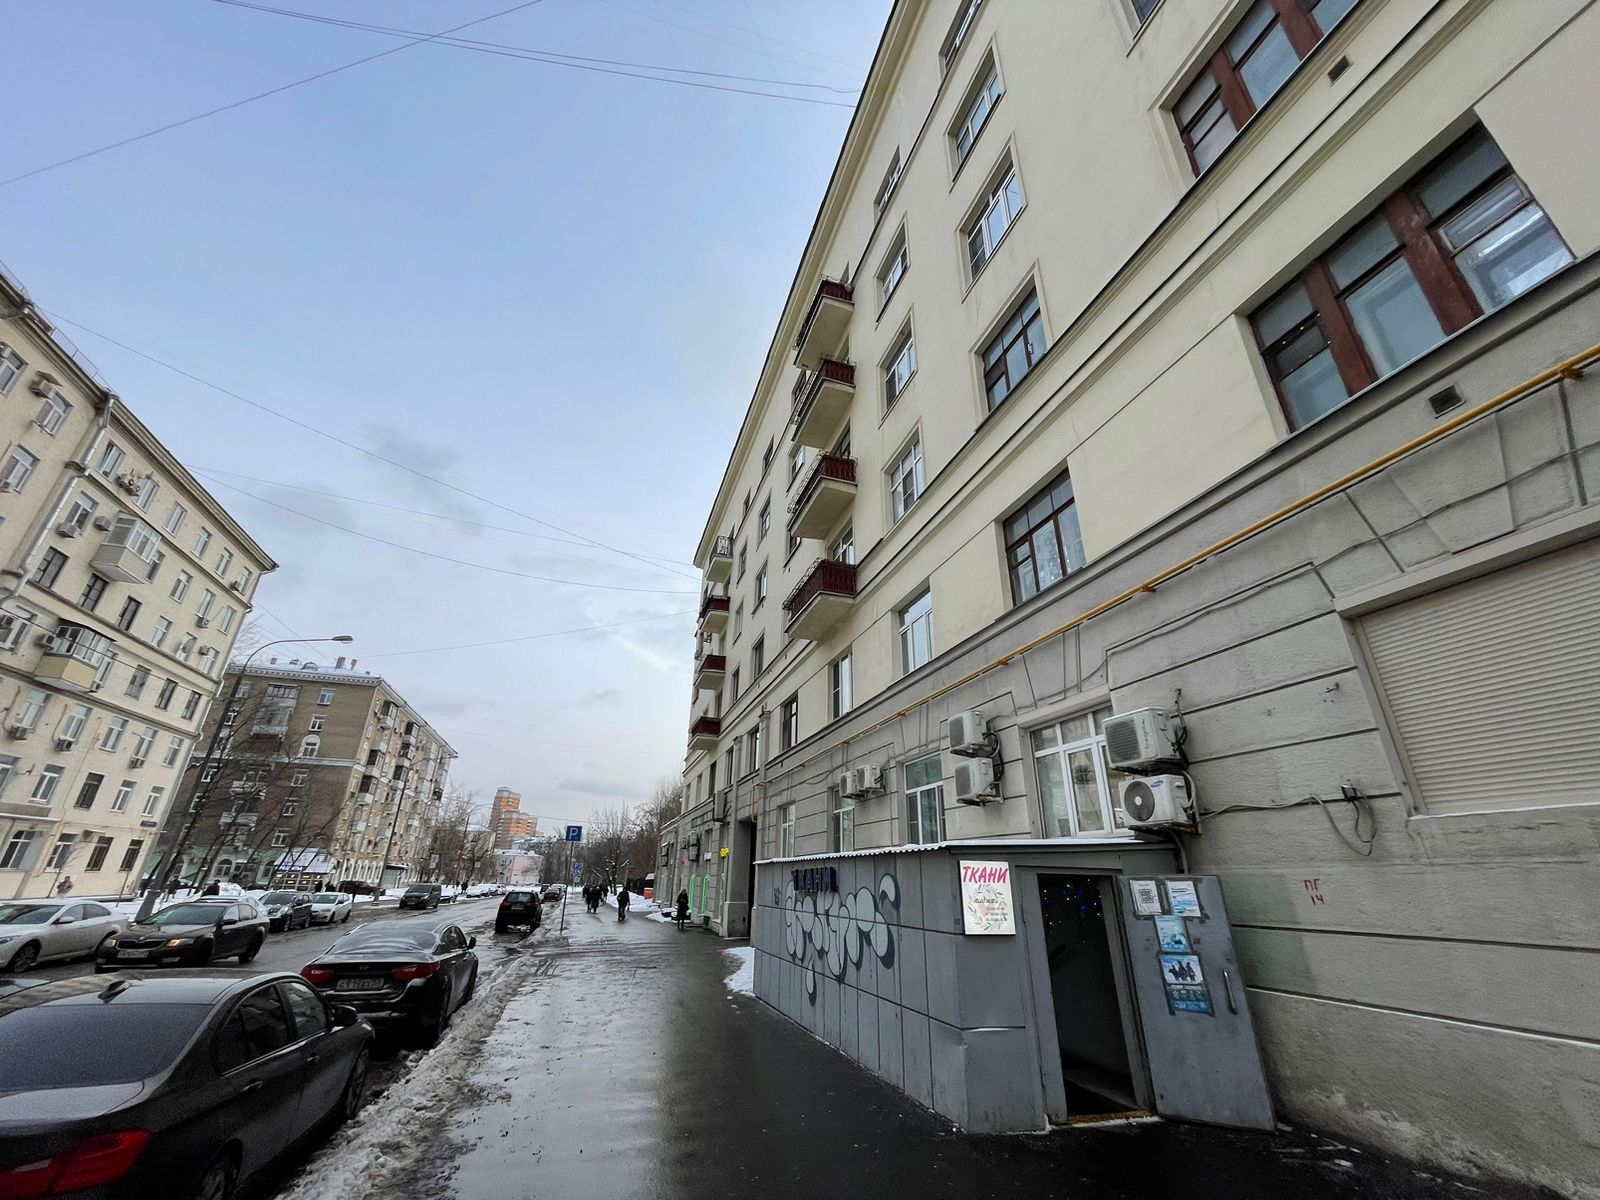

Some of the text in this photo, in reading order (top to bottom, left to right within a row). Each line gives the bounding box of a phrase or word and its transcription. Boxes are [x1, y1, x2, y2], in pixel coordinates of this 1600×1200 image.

[569, 827, 579, 840] P
[962, 865, 1009, 884] ТКАНИ
[1303, 878, 1320, 891] ПГ
